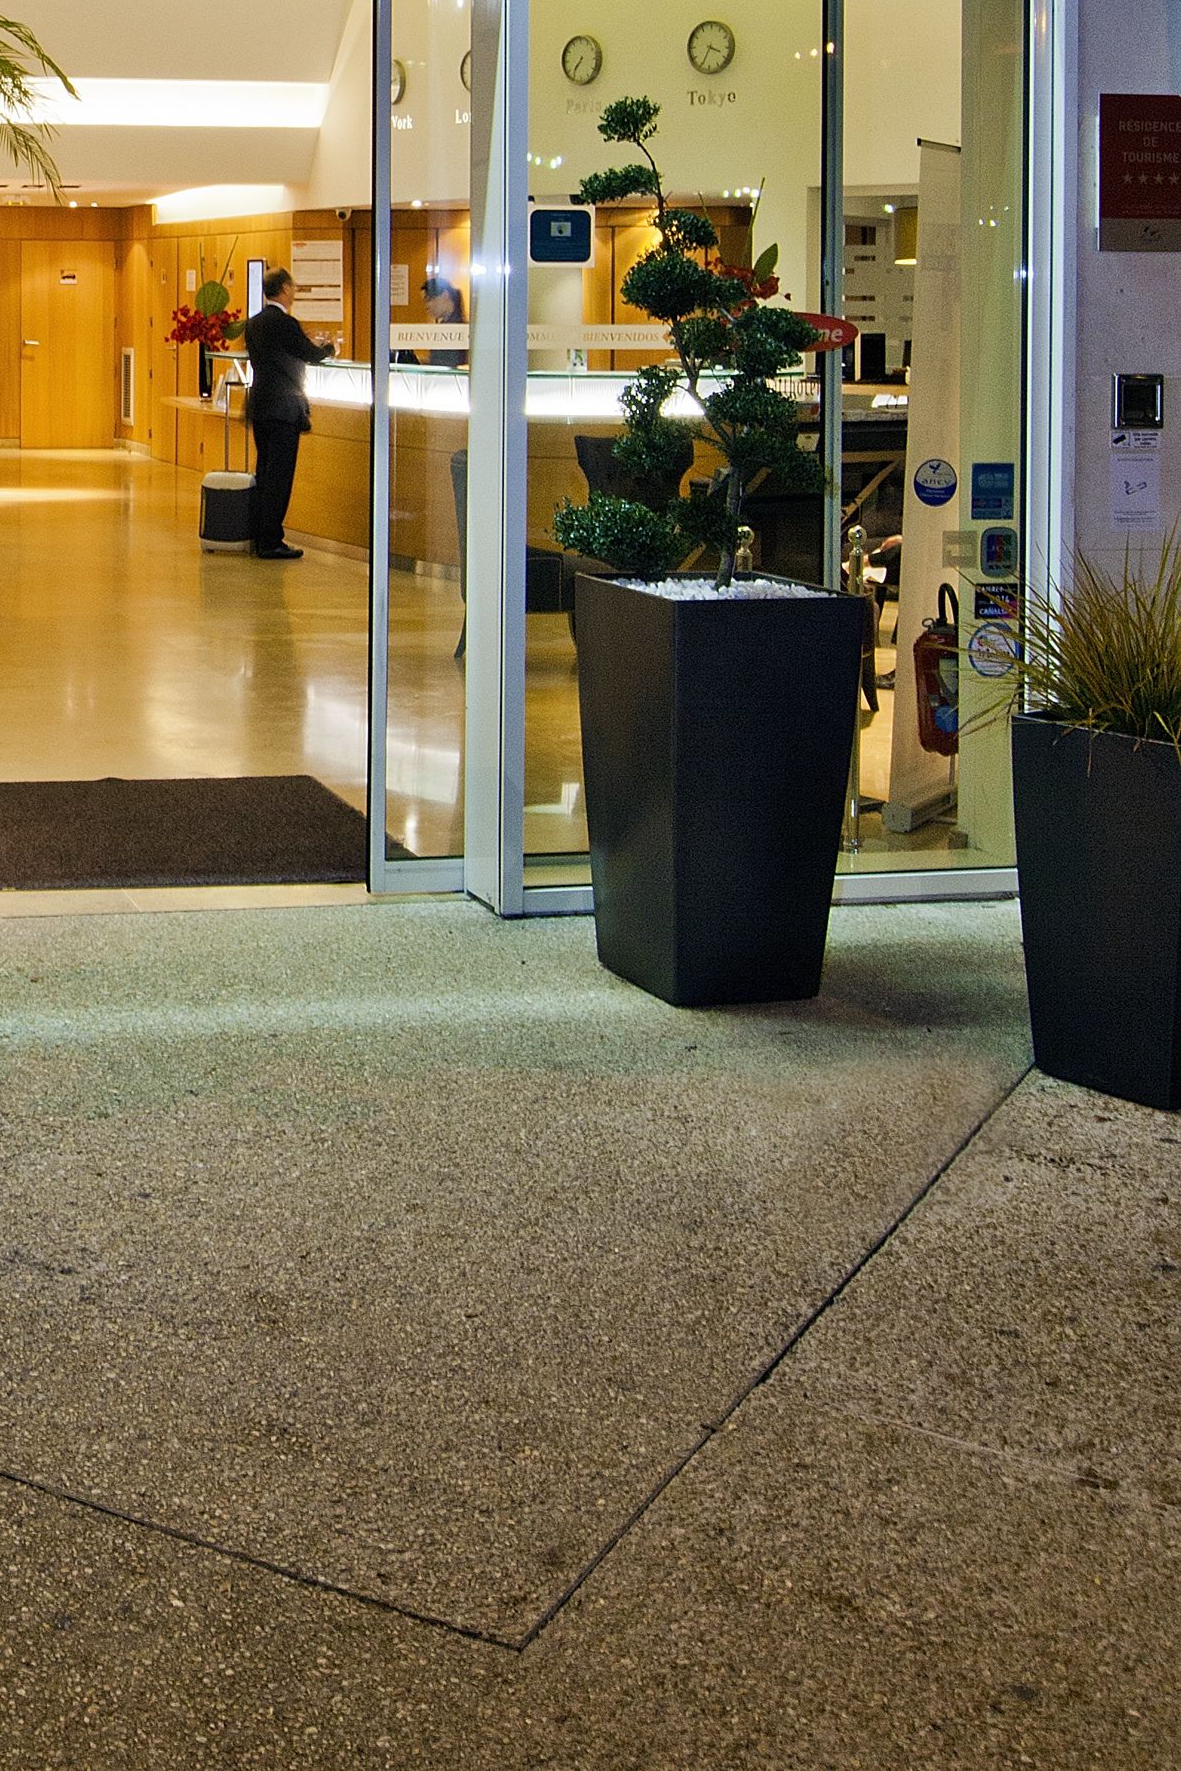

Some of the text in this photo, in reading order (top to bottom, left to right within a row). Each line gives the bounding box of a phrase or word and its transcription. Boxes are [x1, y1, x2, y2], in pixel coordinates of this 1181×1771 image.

[686, 90, 737, 108] Tokyo
[1142, 136, 1159, 148] DE
[1122, 150, 1180, 164] TOURISME
[397, 331, 465, 342] BIENVENUE
[582, 331, 660, 342] BIENVENIDOS
